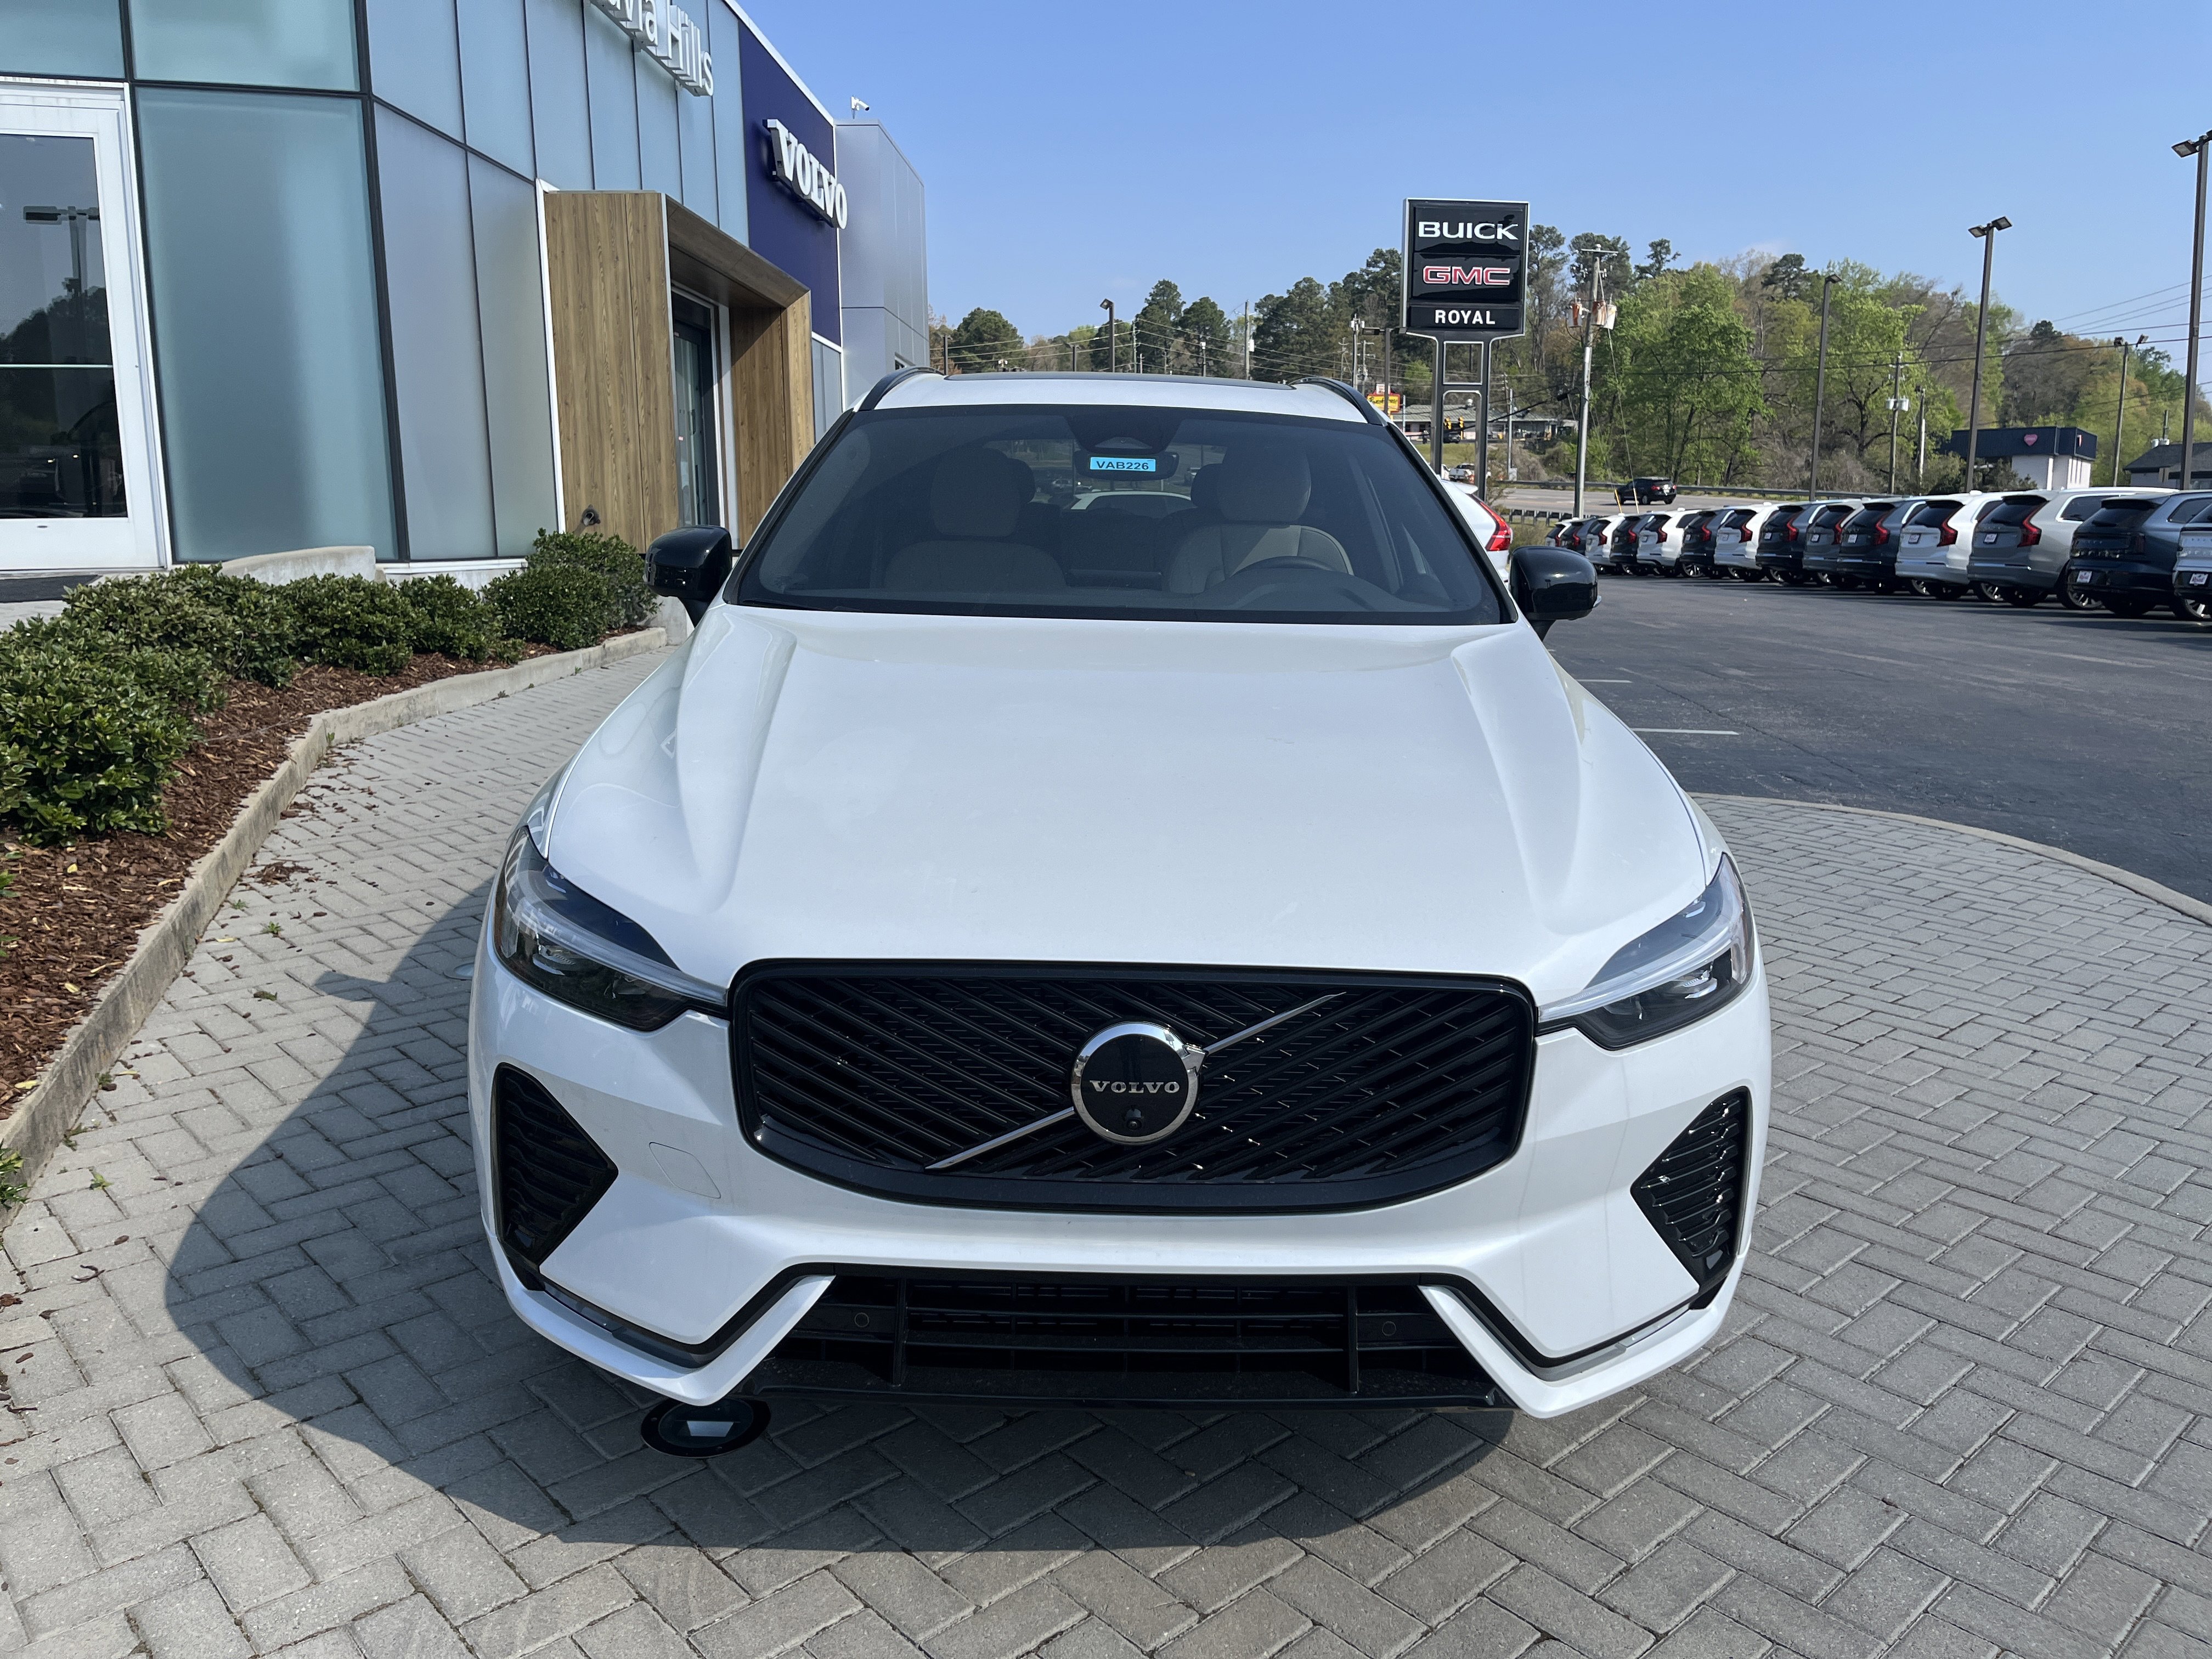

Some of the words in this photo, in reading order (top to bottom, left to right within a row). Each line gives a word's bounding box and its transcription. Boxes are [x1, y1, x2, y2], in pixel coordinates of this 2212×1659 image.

[663, 0, 713, 96] Hills
[766, 118, 848, 230] VOLVO
[1418, 222, 1519, 240] BUICK
[1423, 266, 1510, 285] GMC
[1435, 310, 1496, 324] ROYAL
[1096, 461, 1149, 470] VAB226
[1089, 1080, 1180, 1093] VOLVO
